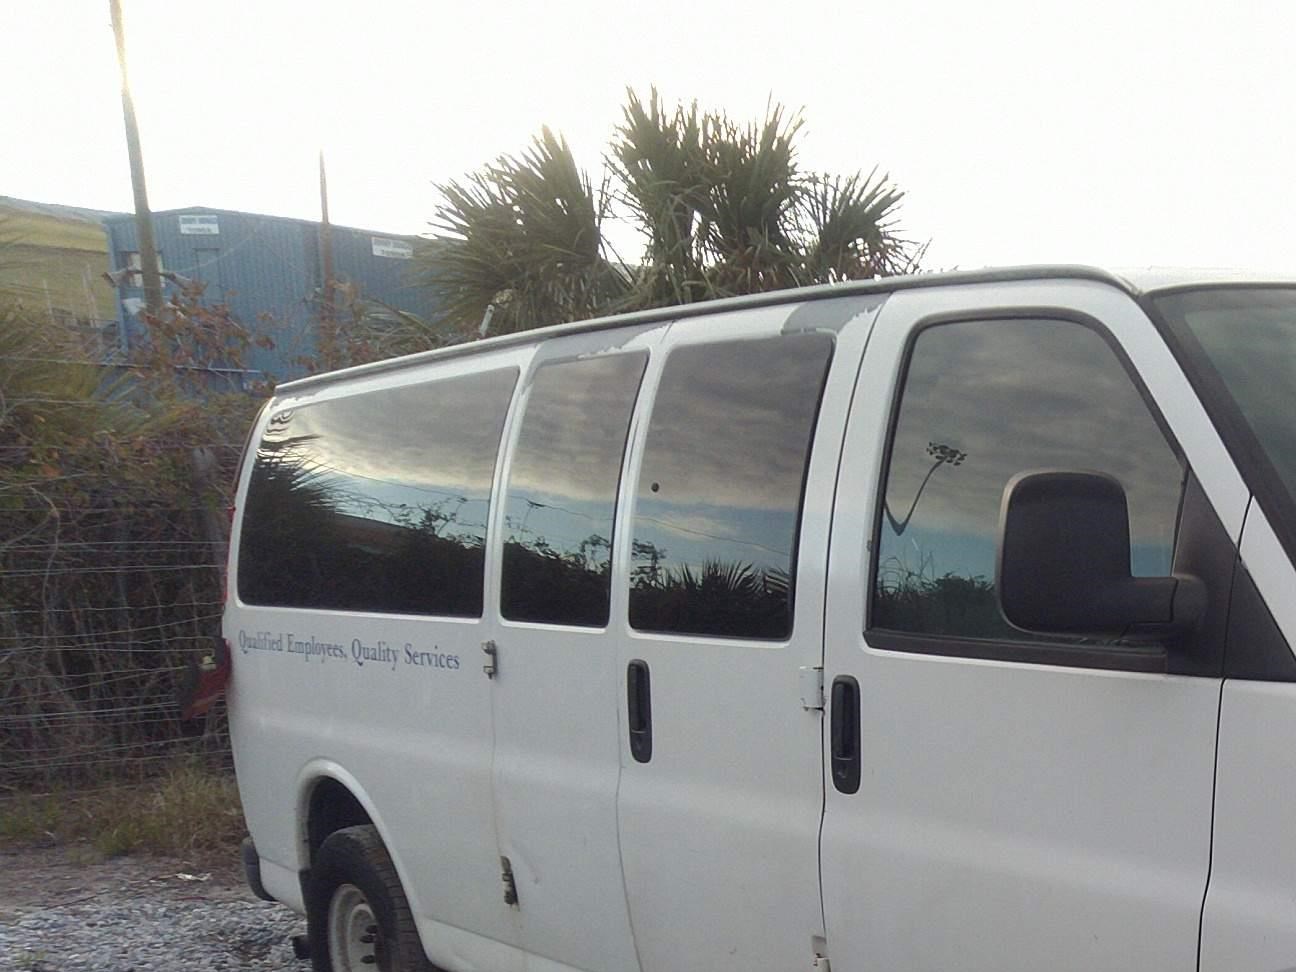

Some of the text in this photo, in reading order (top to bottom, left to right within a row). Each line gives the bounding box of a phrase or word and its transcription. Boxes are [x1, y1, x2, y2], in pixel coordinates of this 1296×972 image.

[239, 630, 282, 654] Qualified
[352, 638, 400, 671] Quality
[404, 643, 460, 669] Services
